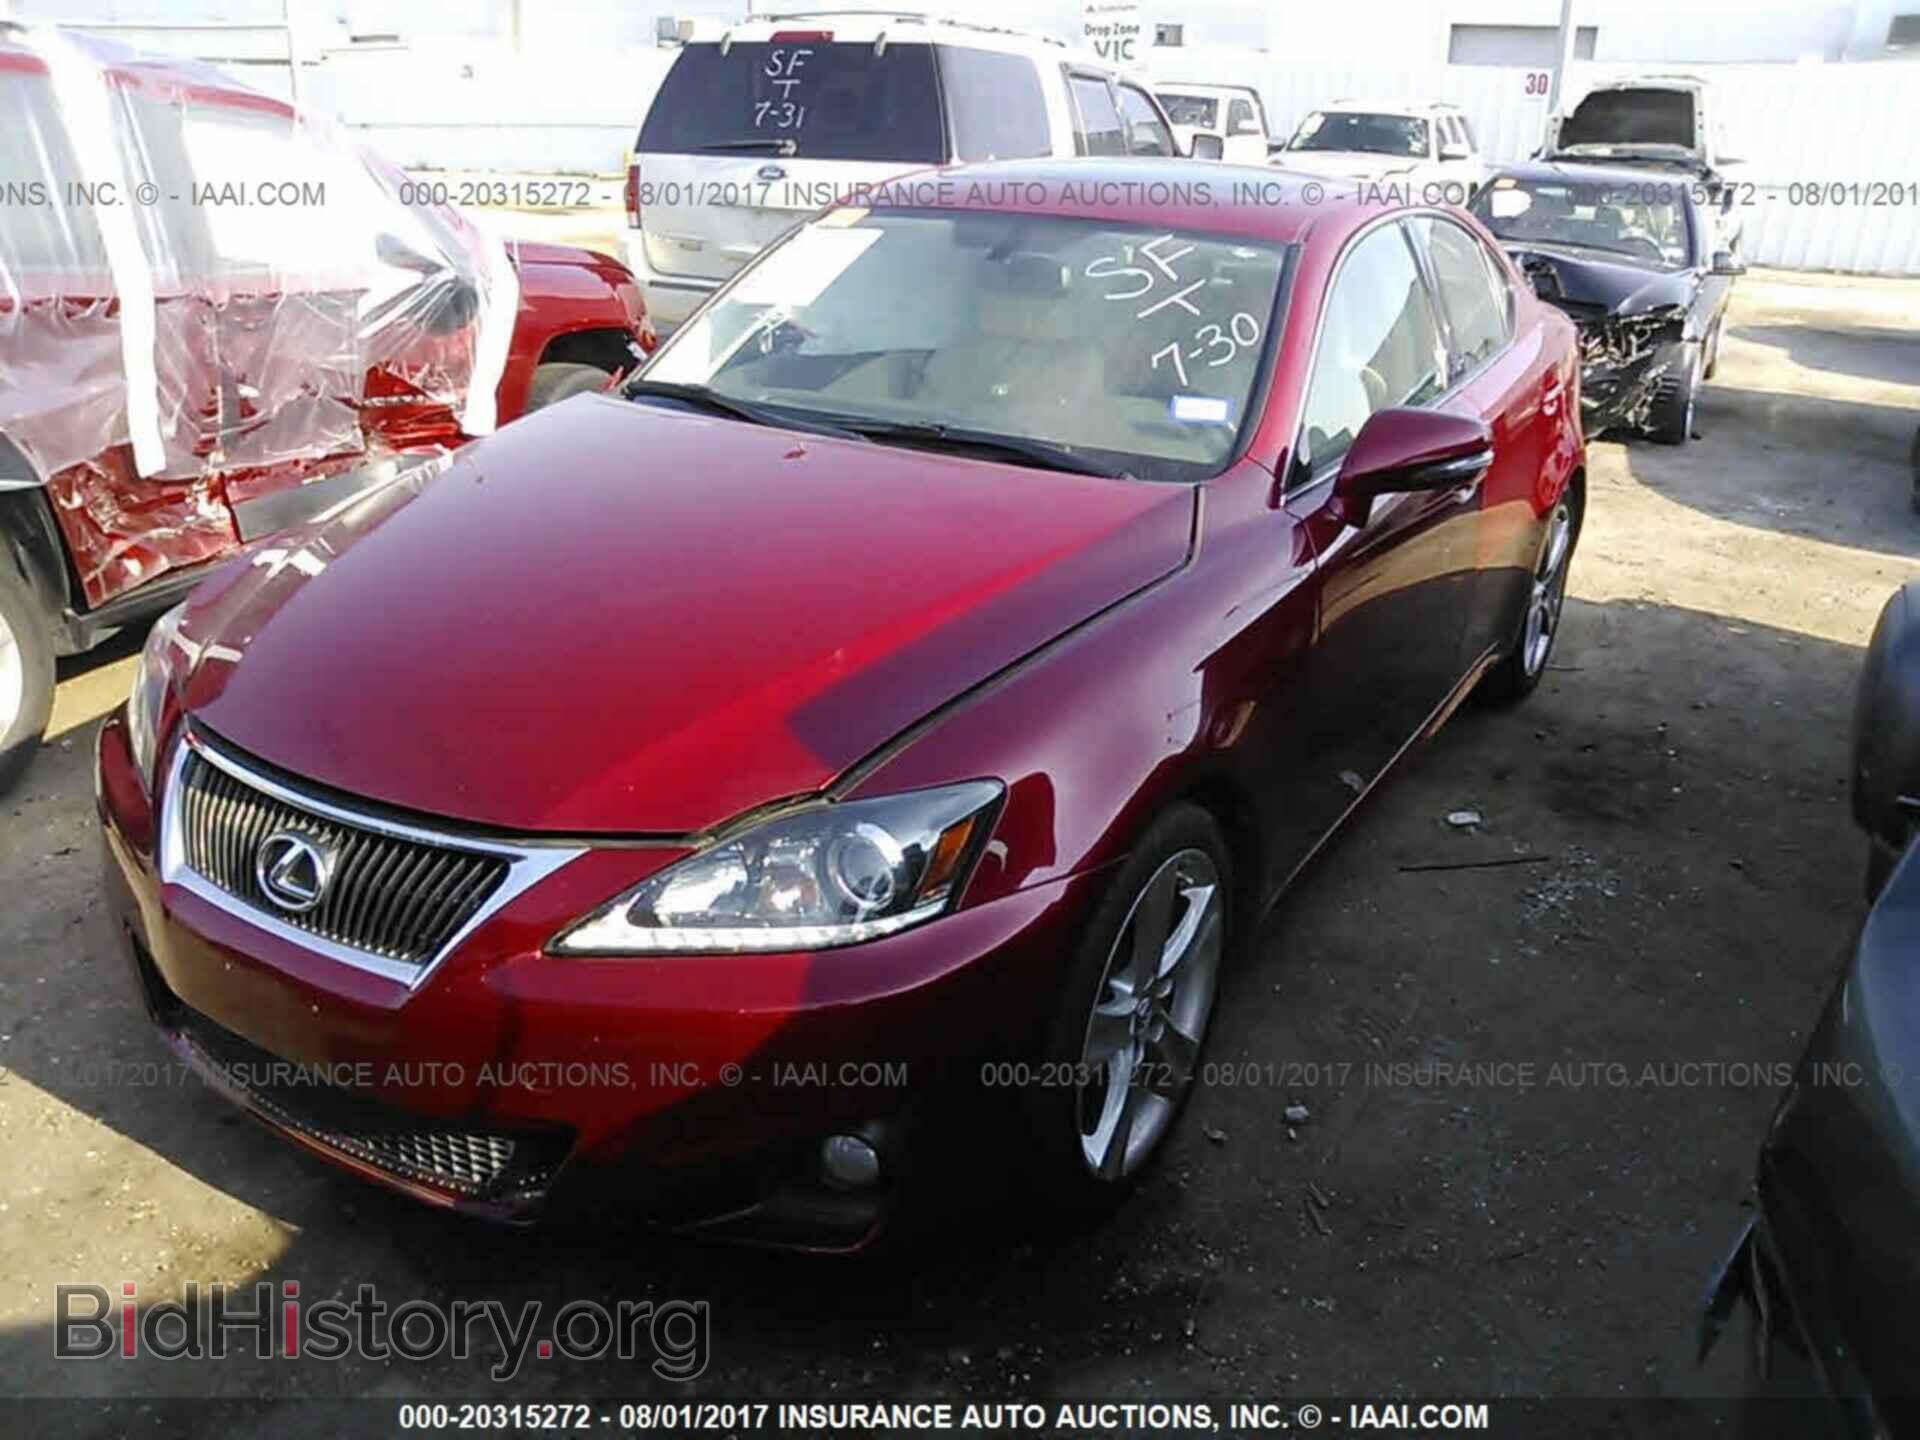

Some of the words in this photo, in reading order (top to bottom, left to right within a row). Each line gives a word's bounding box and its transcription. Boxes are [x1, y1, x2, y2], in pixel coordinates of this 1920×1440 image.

[765, 49, 814, 77] SF
[1094, 38, 1135, 62] VIC
[1525, 73, 1549, 95] 30
[755, 101, 805, 128] 7-31
[1085, 234, 1198, 300] SF
[1152, 312, 1260, 387] 7-30
